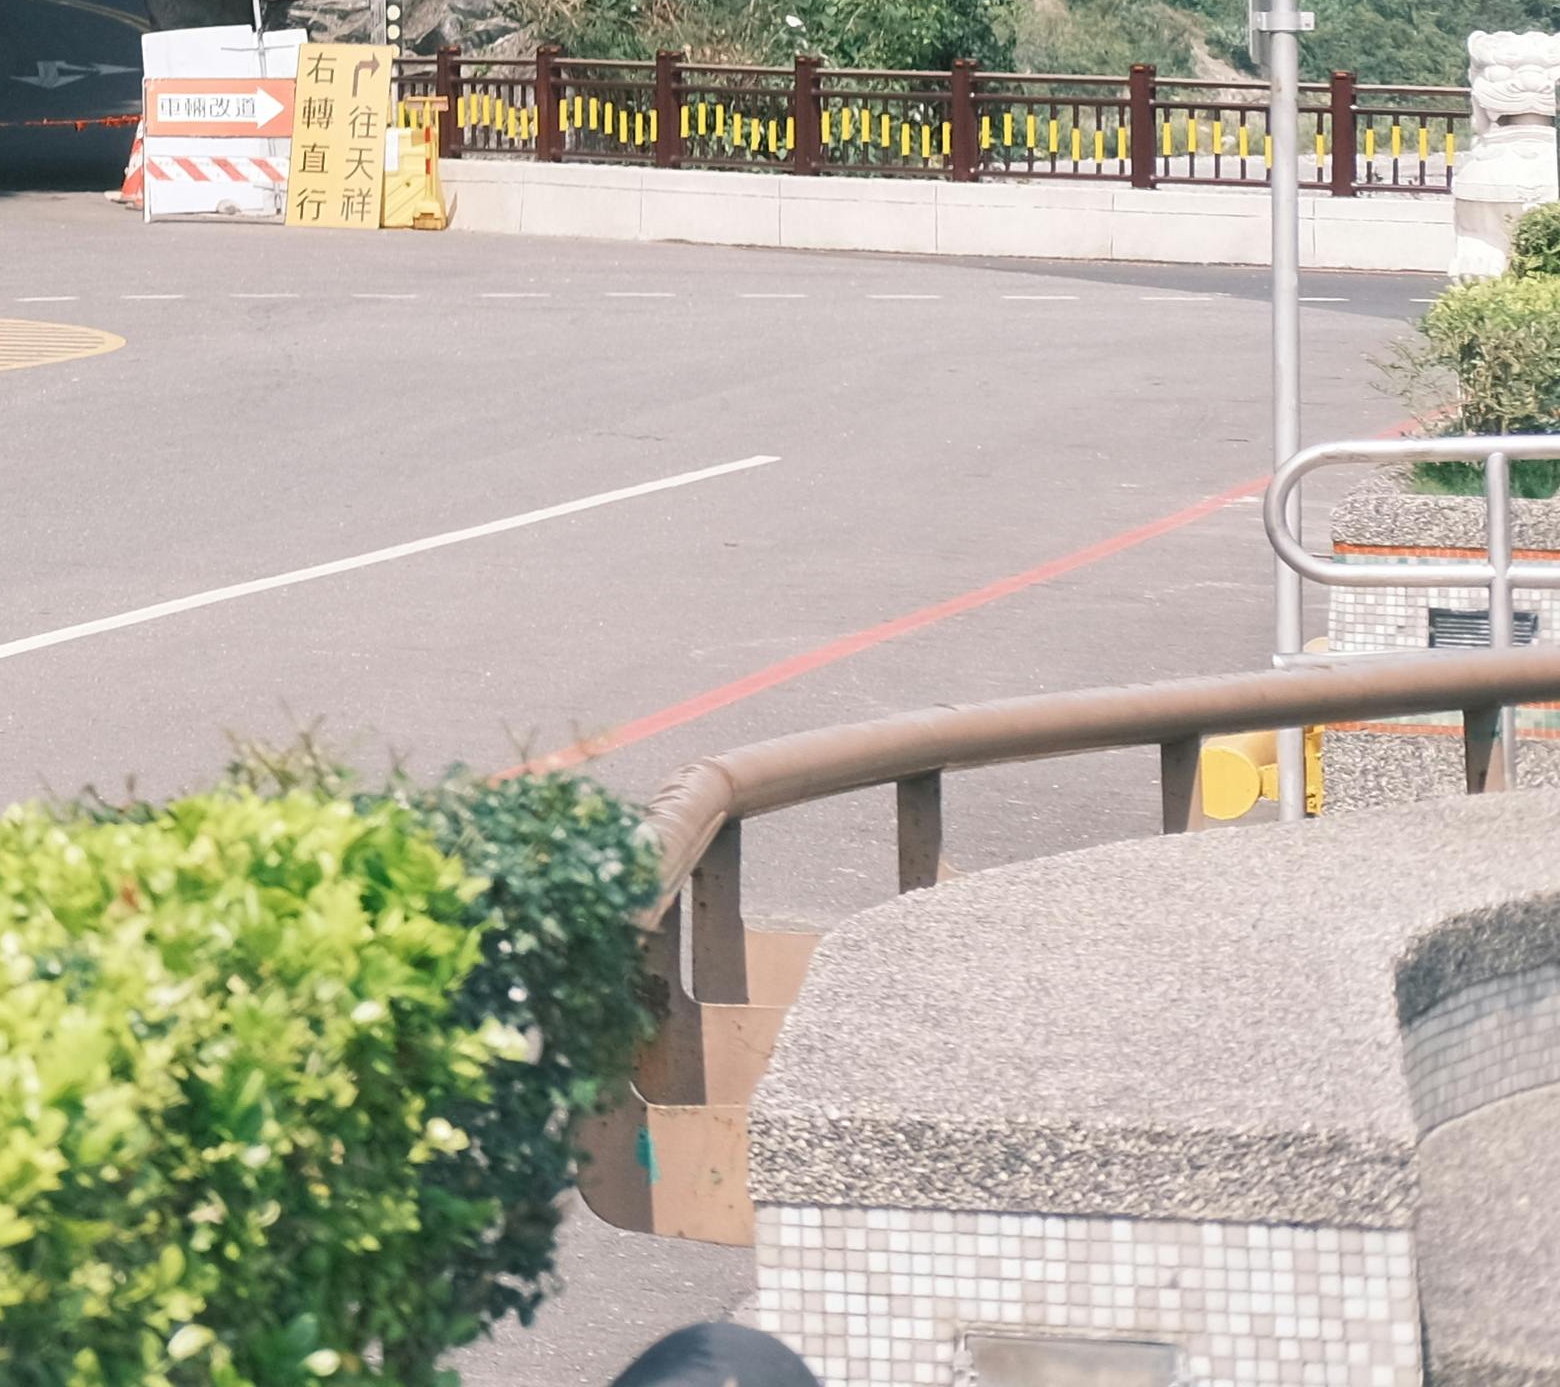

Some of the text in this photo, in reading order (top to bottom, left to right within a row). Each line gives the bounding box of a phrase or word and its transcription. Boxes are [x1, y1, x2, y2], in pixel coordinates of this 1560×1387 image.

[160, 96, 257, 119] 車輛改道
[296, 52, 338, 222] 右轉直行
[340, 104, 379, 222] 往天祥
